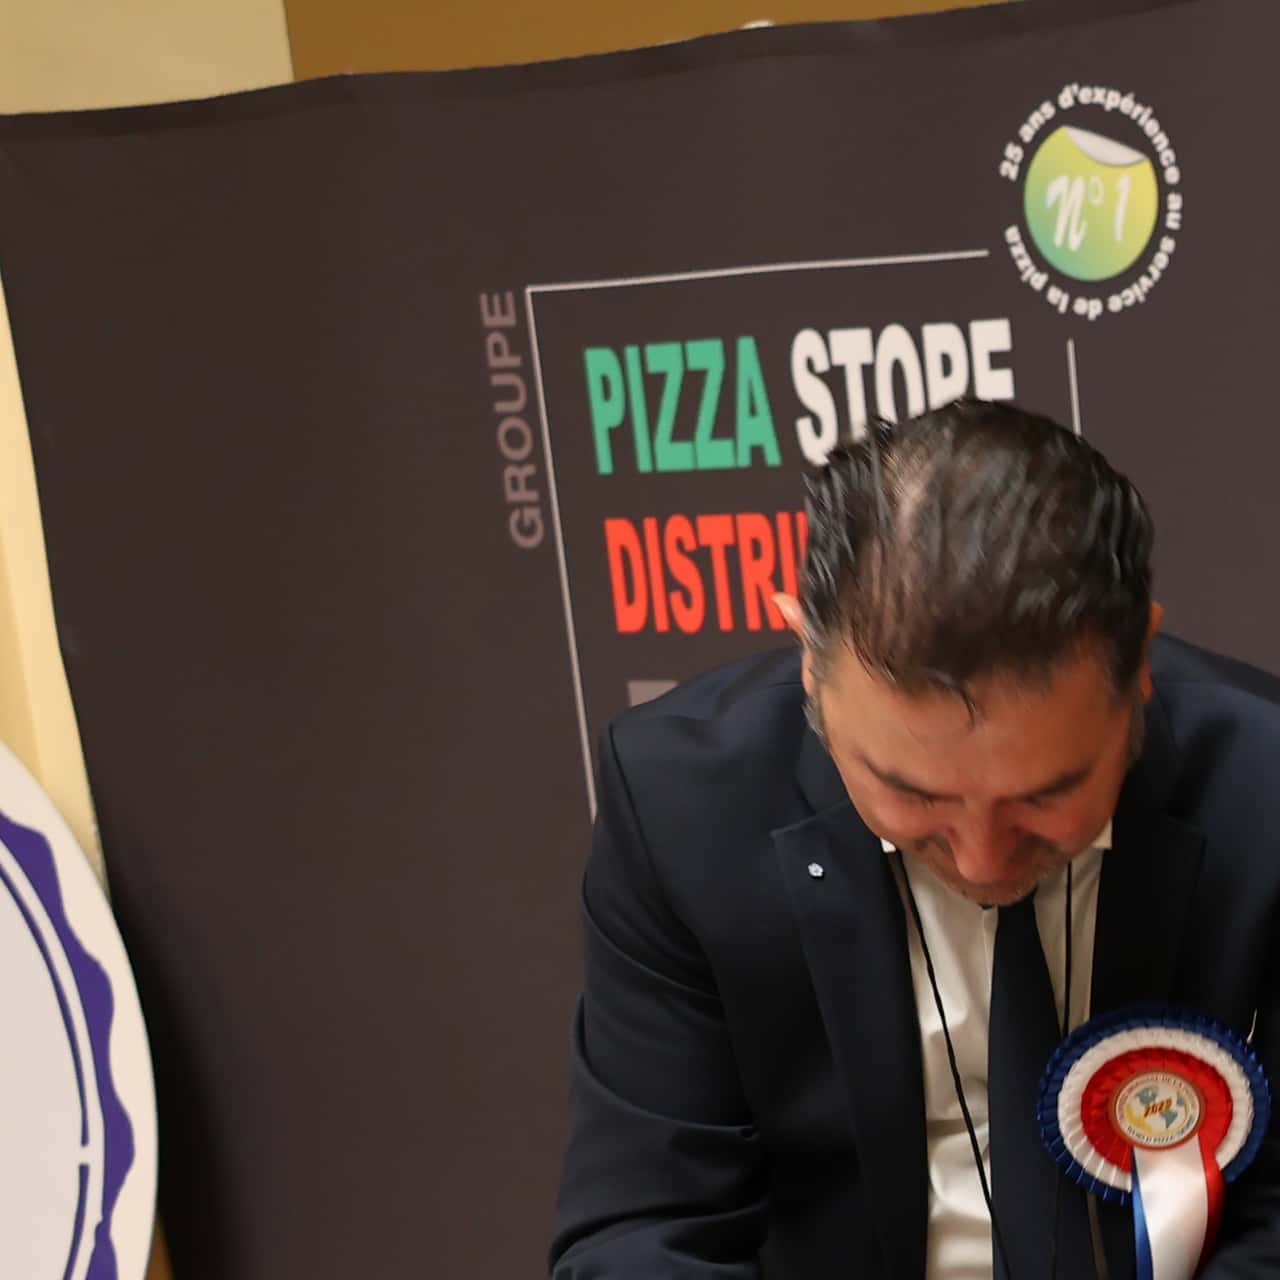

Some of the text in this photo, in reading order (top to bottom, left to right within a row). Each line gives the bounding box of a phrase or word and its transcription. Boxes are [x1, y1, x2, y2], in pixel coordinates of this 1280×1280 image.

[999, 81, 1183, 322] 25 ans d'expérience au service de la pizza
[480, 289, 545, 549] GROUPE
[584, 335, 782, 475] PIZZA
[603, 510, 808, 634] DISTRI
